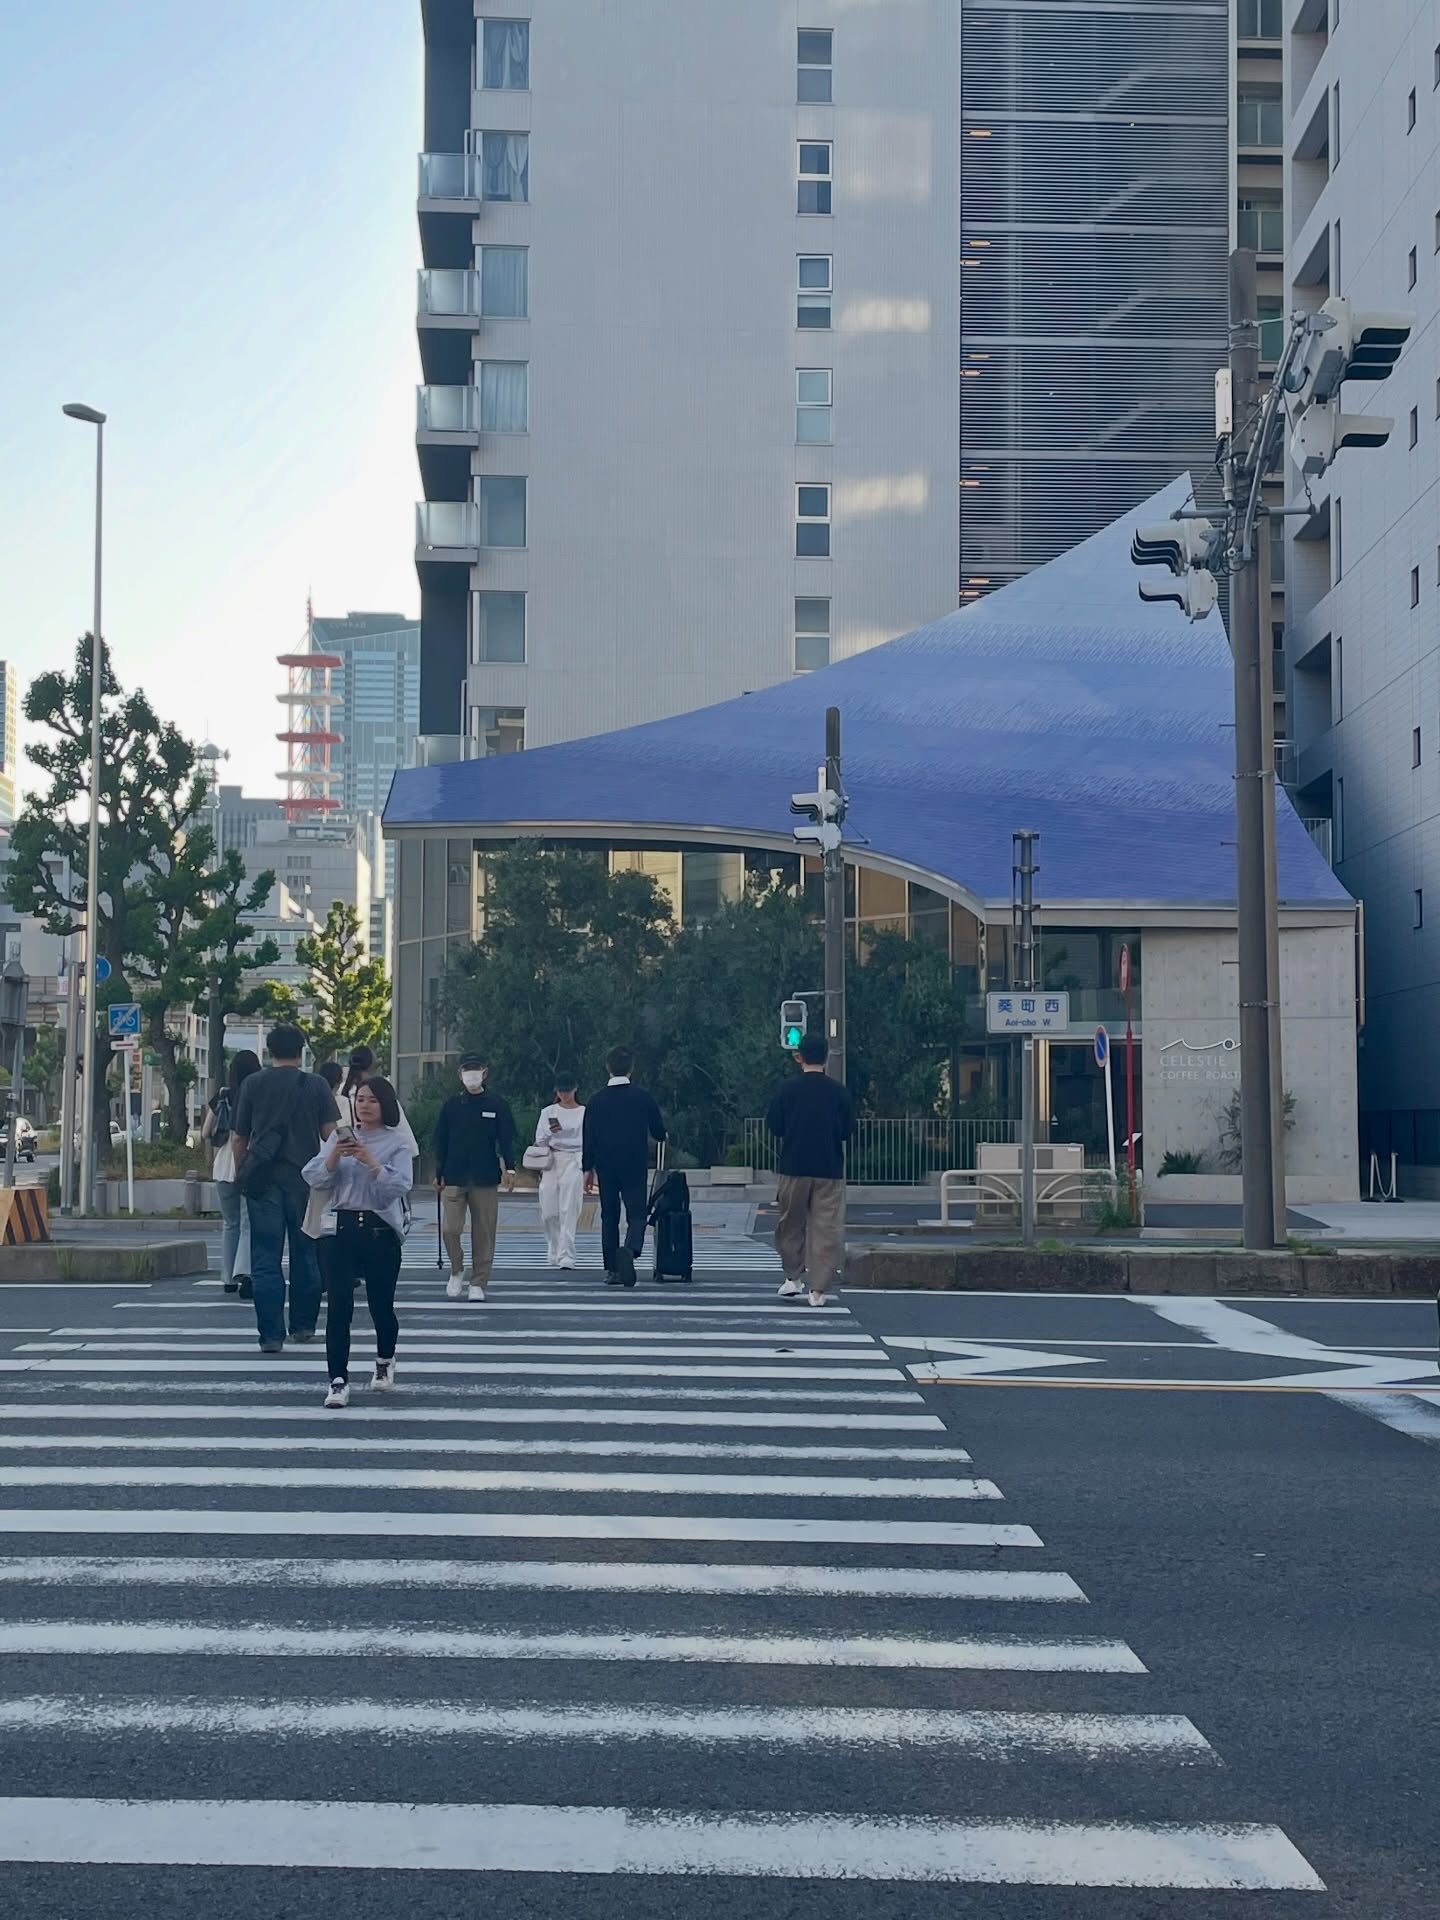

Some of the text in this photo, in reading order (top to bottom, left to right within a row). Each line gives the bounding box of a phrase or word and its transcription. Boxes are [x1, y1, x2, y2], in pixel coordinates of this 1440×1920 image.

[997, 998, 1060, 1013] 葵町西
[1005, 1018, 1037, 1026] Aoi-cho
[1159, 1070, 1241, 1080] COFFEE ROAST
